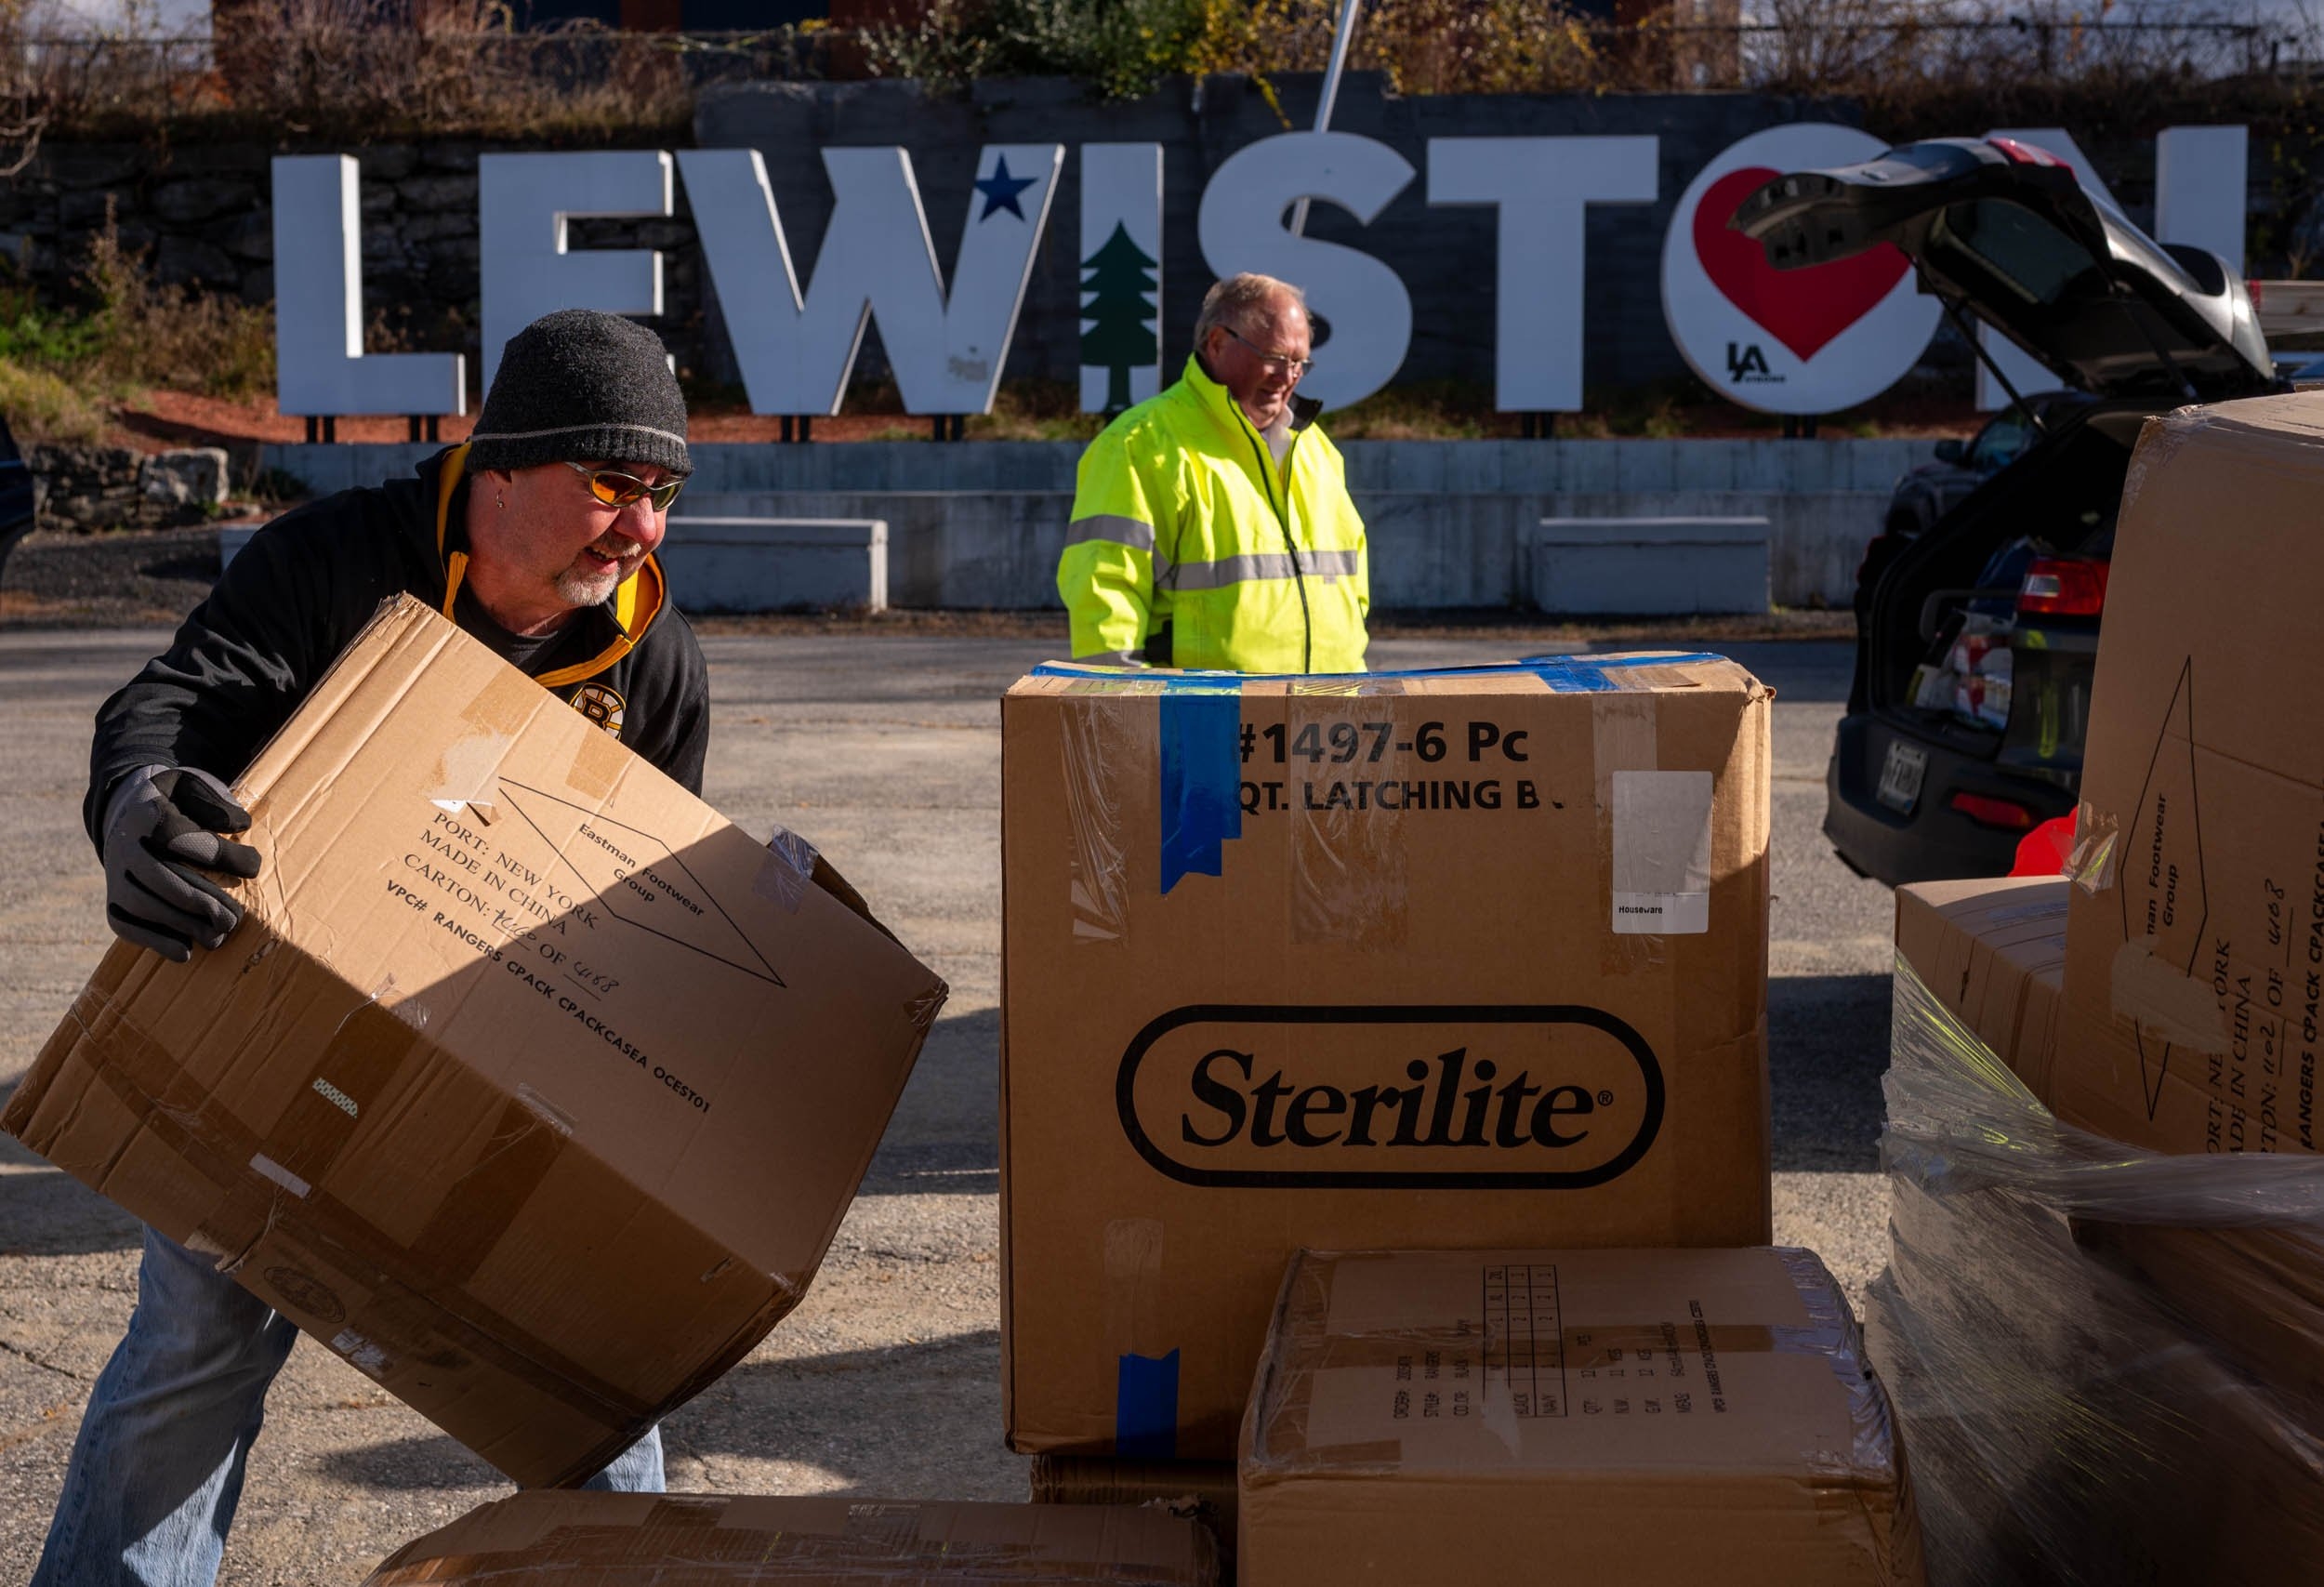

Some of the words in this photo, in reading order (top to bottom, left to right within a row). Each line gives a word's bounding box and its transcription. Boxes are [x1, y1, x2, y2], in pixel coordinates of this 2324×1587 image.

[1468, 721, 1529, 761] Pc
[1304, 780, 1500, 811] LATCHING
[433, 812, 490, 855] PORT:
[495, 852, 543, 887] NEW
[547, 884, 600, 930] YORK
[579, 823, 637, 868] Eastman
[641, 866, 705, 916] Footwear
[2148, 792, 2167, 889] Footwear
[403, 853, 491, 917] CARTON:
[539, 943, 567, 965] OF
[420, 828, 482, 875] MADE
[482, 870, 507, 892] IN
[508, 888, 567, 935] CHINA
[613, 867, 656, 904] Group
[1618, 905, 1664, 916] Houseware
[2162, 864, 2179, 928] Group
[387, 879, 429, 911] VPC#
[432, 911, 504, 962] RANGERS
[507, 960, 556, 999] CPACK
[558, 996, 649, 1068] CPACKCASEA
[653, 1065, 711, 1114] OCEST01
[2213, 937, 2231, 1012] ORK
[2267, 967, 2284, 1007] OF
[2233, 975, 2251, 1062] CHINA
[2304, 971, 2321, 1044] CPACK
[2208, 1052, 2224, 1088] NE
[2231, 1067, 2246, 1099] IN
[2207, 1096, 2225, 1154] ORT:
[2228, 1105, 2247, 1154] ADE
